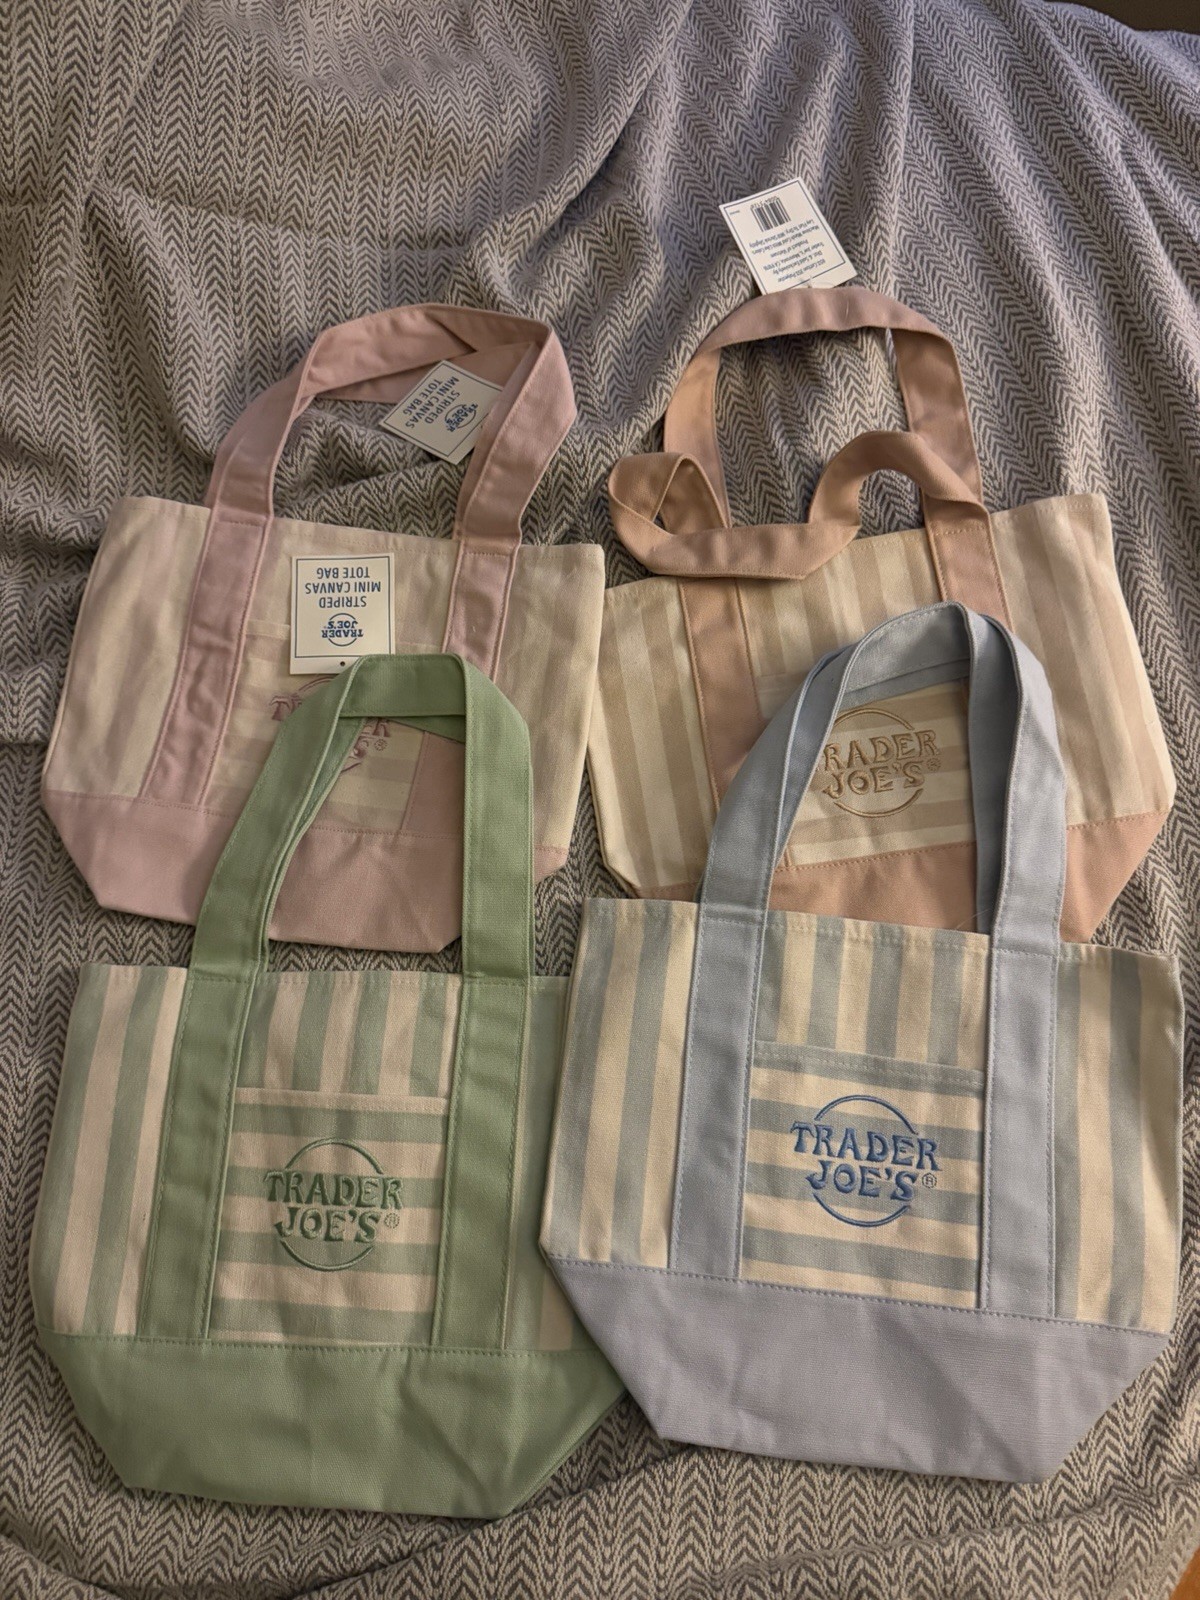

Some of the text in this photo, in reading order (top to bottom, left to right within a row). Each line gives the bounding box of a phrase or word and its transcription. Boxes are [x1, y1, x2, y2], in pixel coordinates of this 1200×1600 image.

[403, 379, 442, 416] TOTE BAG
[405, 376, 460, 429] MINI CANVAS
[424, 390, 460, 424] STRIPED
[447, 403, 478, 433] TRADER
[305, 581, 381, 594] MINI CANVAS
[316, 566, 370, 579] TOTE BAG
[319, 595, 367, 608] STRIPED
[321, 628, 364, 639] TRADER
[820, 730, 938, 771] RADER
[790, 1121, 943, 1171] TRADER
[263, 1170, 403, 1210] TRADER
